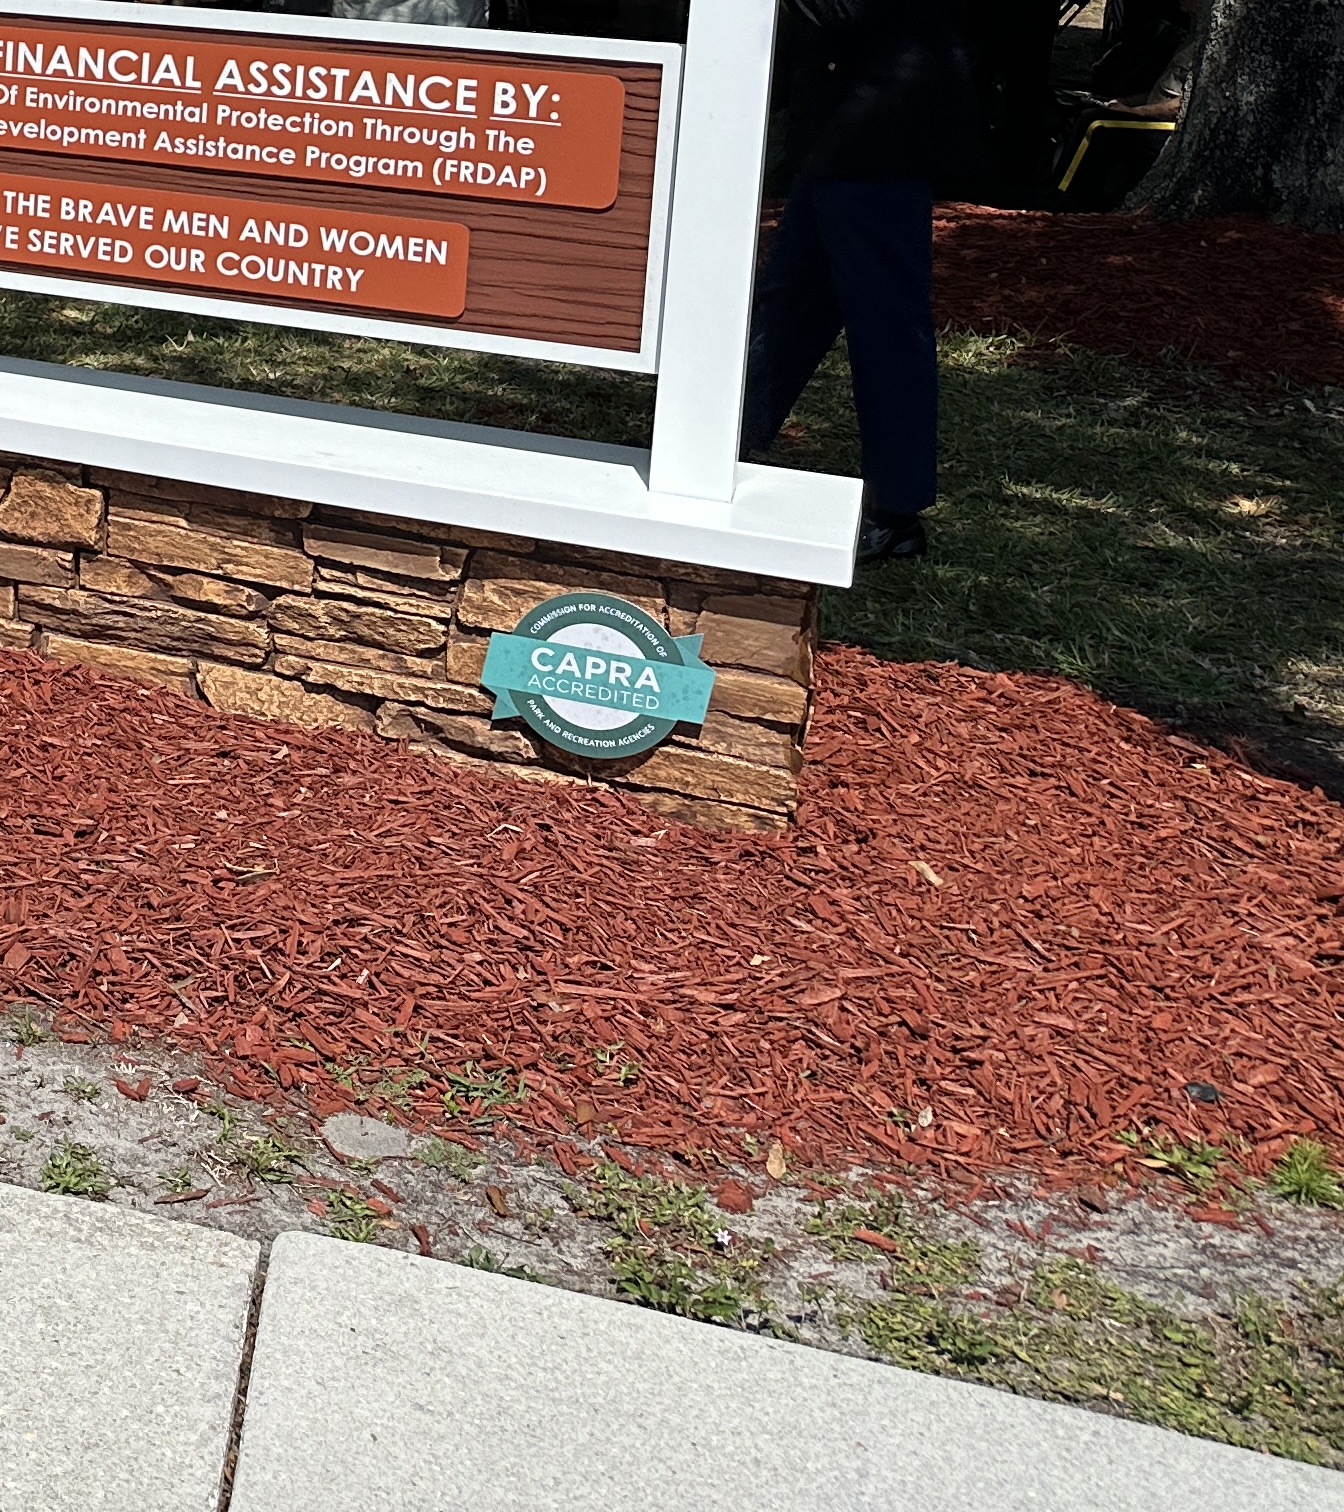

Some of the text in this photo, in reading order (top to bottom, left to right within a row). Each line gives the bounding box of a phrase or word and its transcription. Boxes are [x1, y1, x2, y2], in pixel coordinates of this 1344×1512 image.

[25, 88, 208, 124] Environmental
[216, 105, 354, 137] Protection
[363, 118, 476, 153] Through
[485, 130, 535, 155] The
[213, 59, 478, 115] ASSISTANCE
[490, 81, 562, 123] BY:
[153, 131, 296, 165] Assistance
[305, 149, 423, 180] Program
[432, 160, 548, 197] (FRDAP)
[3, 191, 51, 218] THE
[60, 196, 153, 231] BRAVE
[162, 209, 229, 239] MEN
[238, 218, 309, 248] AND
[319, 227, 448, 265] WOMEN
[27, 228, 133, 264] SERVED
[144, 244, 206, 273] OUR
[215, 252, 365, 293] COUNTRY
[530, 604, 668, 658] COMMISSION FOR ACCREDITATION OF
[527, 674, 660, 710] ACCREDITED
[530, 647, 661, 693] CAPRA
[527, 699, 656, 748] PARK AND RECREATION AGENCIES
